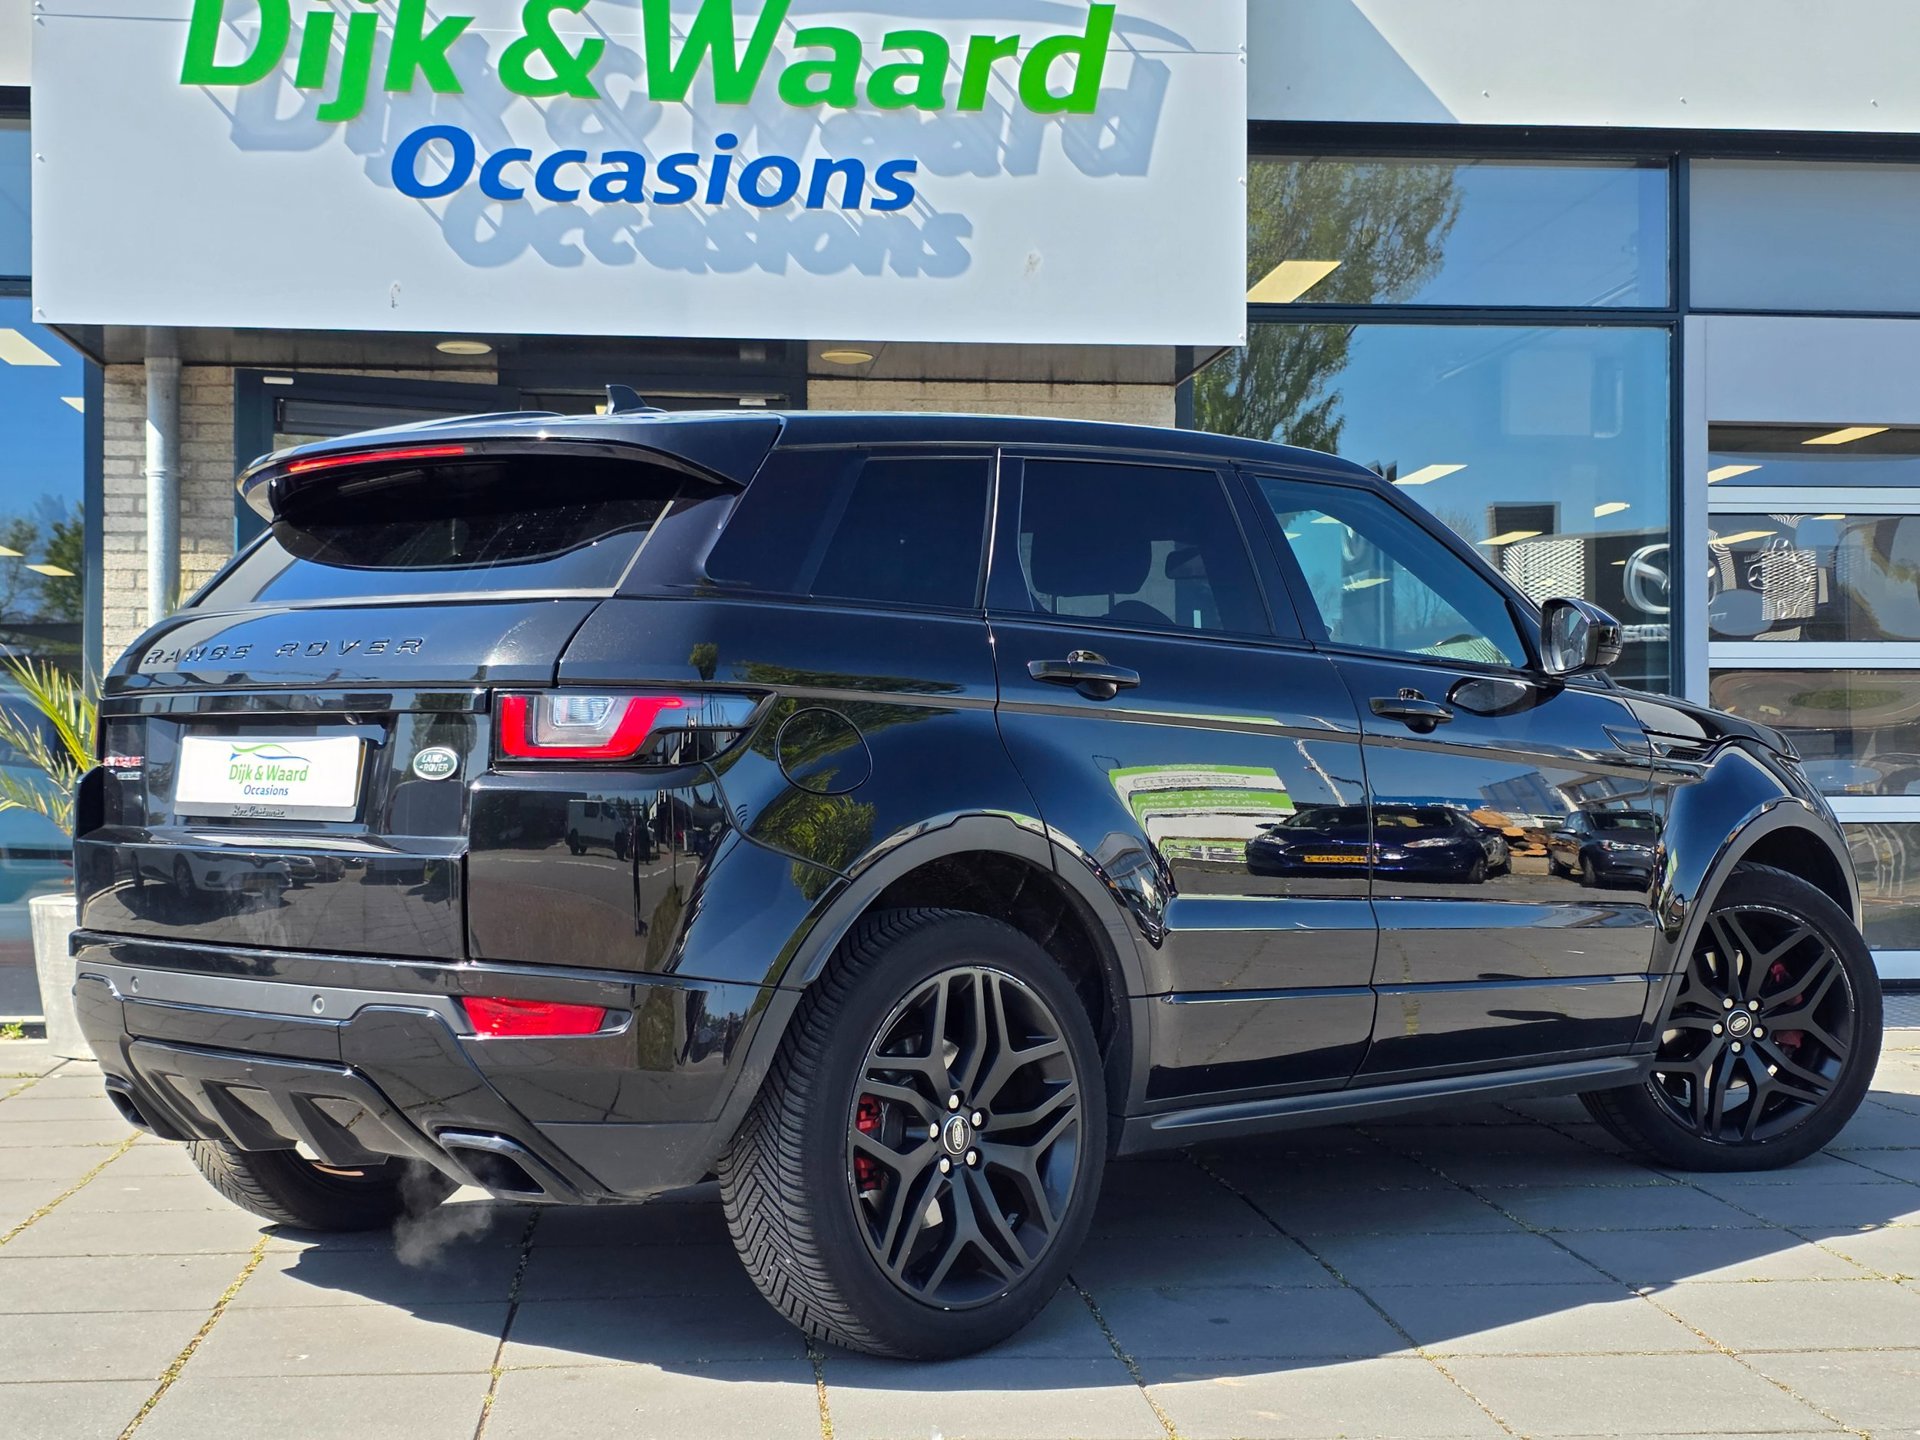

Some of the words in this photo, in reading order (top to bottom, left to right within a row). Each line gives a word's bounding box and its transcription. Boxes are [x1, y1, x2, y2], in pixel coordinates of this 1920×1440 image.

[181, 0, 470, 122] Dijk
[500, 0, 604, 98] &
[643, 0, 1115, 114] Waard
[392, 124, 917, 211] Occasions
[143, 644, 254, 665] RANGE
[274, 637, 425, 658] ROVER
[422, 754, 443, 763] LAND
[423, 763, 449, 772] ROVER
[228, 764, 253, 784] Dijk
[254, 765, 264, 780] &
[266, 764, 309, 781] Waard
[243, 784, 289, 796] Occasions
